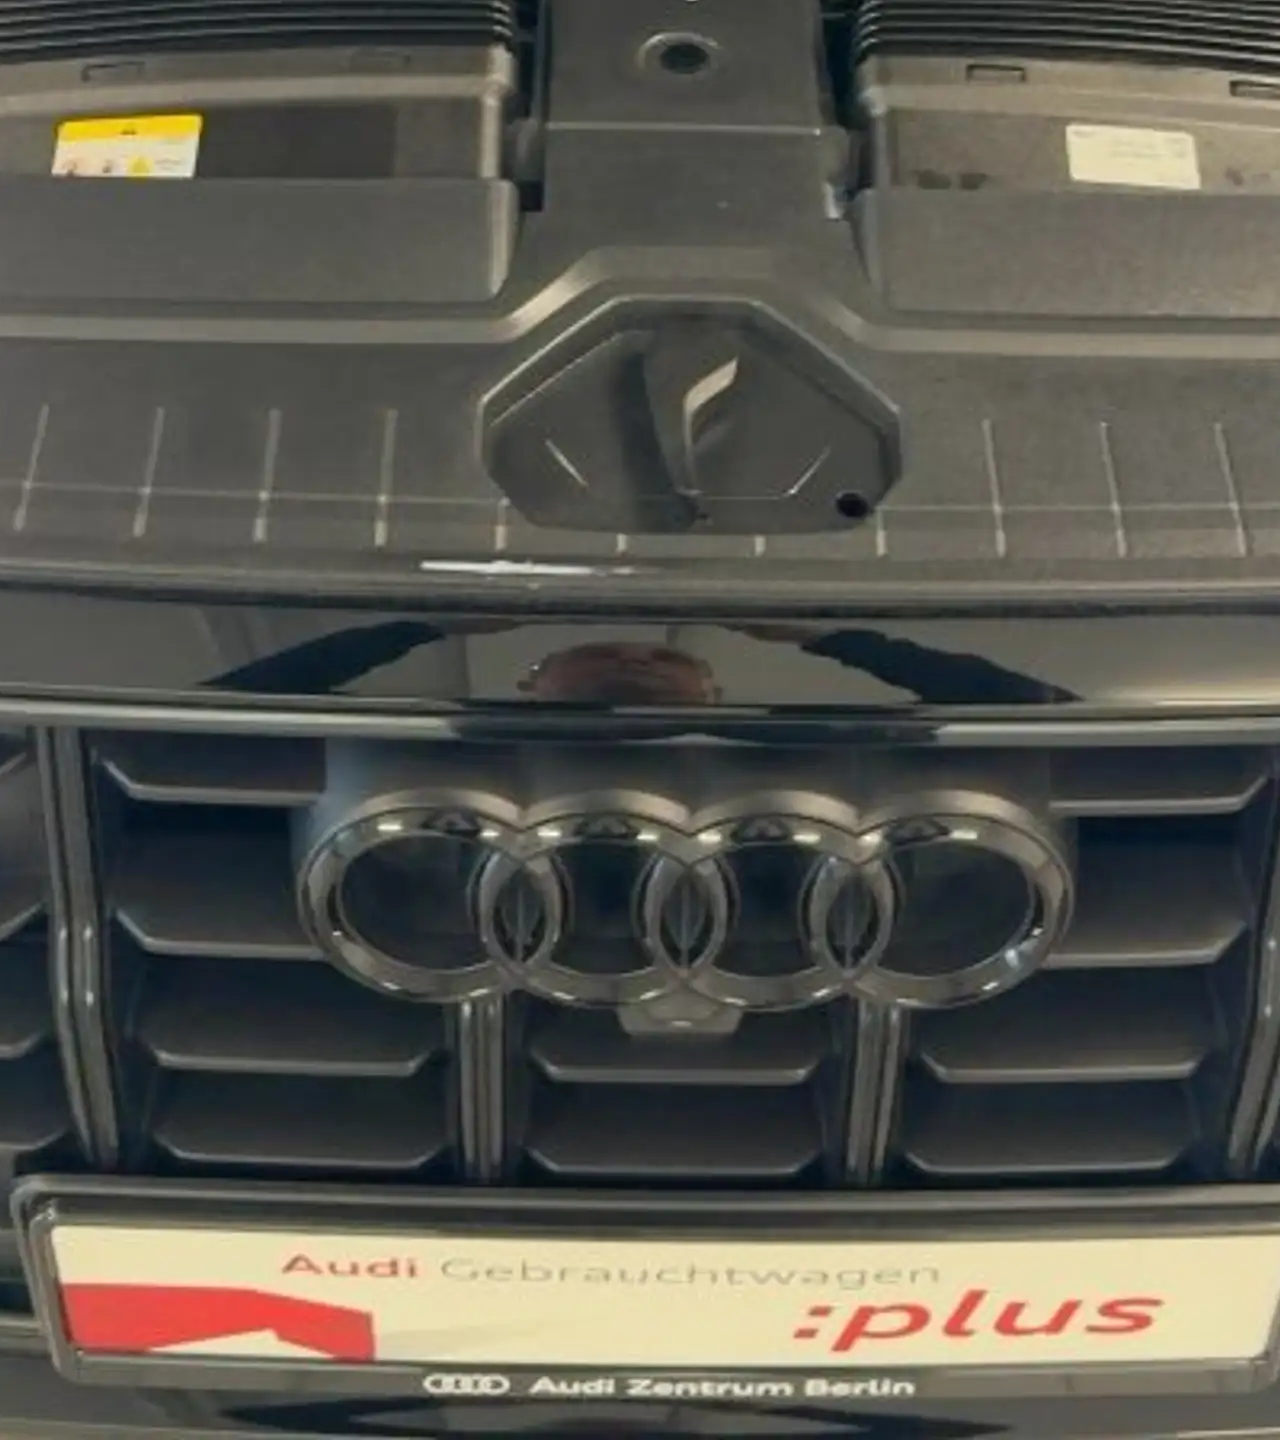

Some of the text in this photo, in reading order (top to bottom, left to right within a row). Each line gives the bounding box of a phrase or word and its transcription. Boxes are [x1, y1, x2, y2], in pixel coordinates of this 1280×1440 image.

[281, 1253, 939, 1291] Audi Gebrauchtwagen
[793, 1288, 1165, 1353] :plus
[529, 1376, 917, 1397] Audi Zentrum Berlin
